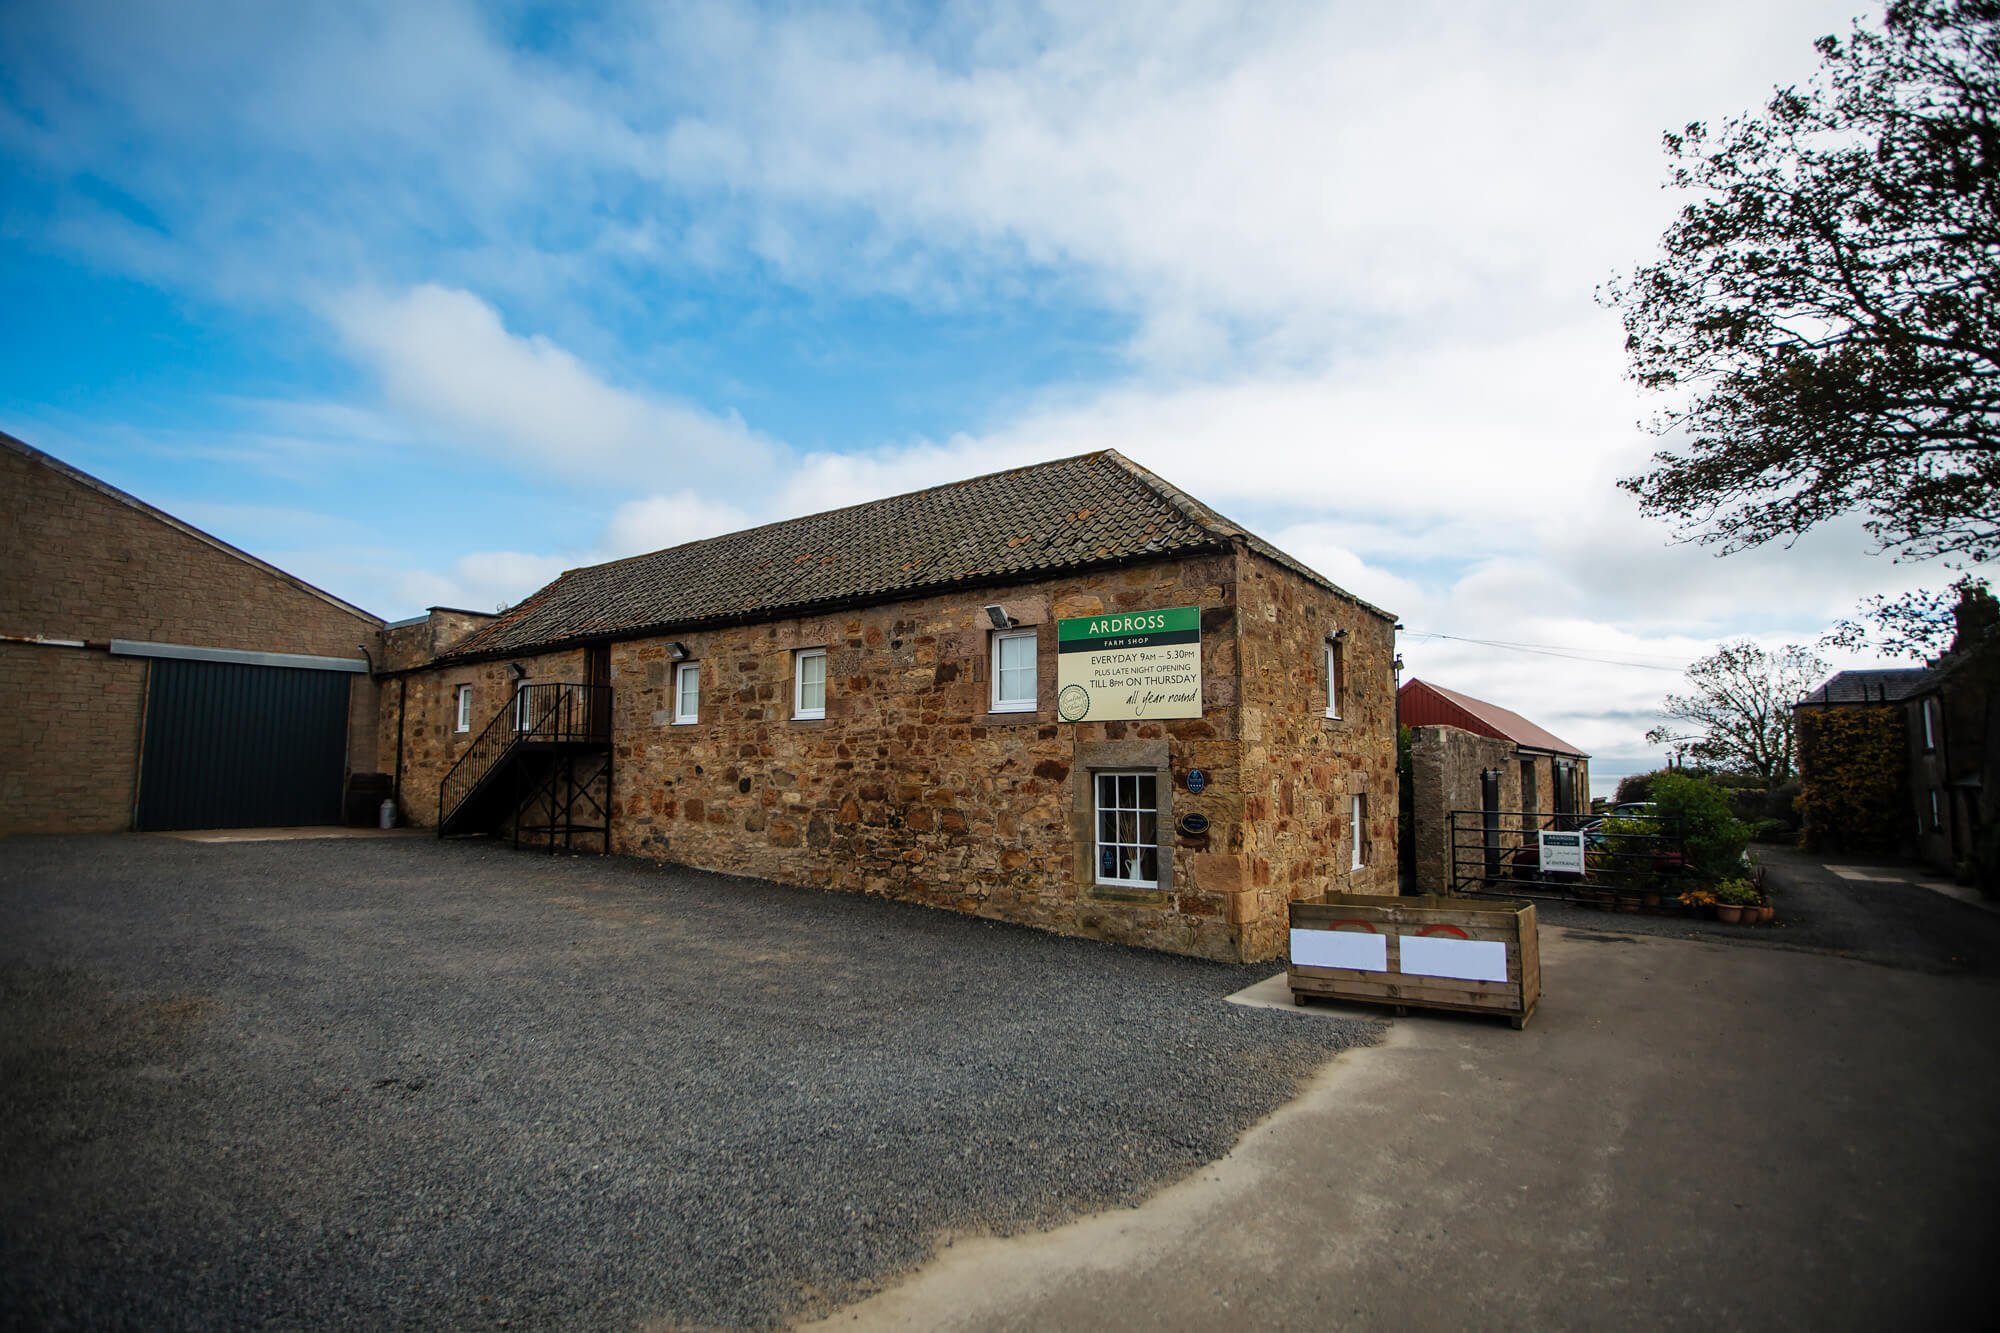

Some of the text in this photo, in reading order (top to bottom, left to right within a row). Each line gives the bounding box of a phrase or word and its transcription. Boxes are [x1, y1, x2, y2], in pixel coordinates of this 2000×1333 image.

[1089, 615, 1165, 634] ARDROSS
[1128, 637, 1149, 645] SHOP
[1091, 653, 1137, 665] EVERYDAY
[1140, 652, 1156, 661] 9AM
[1167, 649, 1195, 660] 5.30PM
[1094, 663, 1191, 677] PLUS LATE NIGHT OPENING
[1089, 674, 1197, 688] TILL 8PM ON THURSDAY
[1126, 688, 1198, 717] all year round
